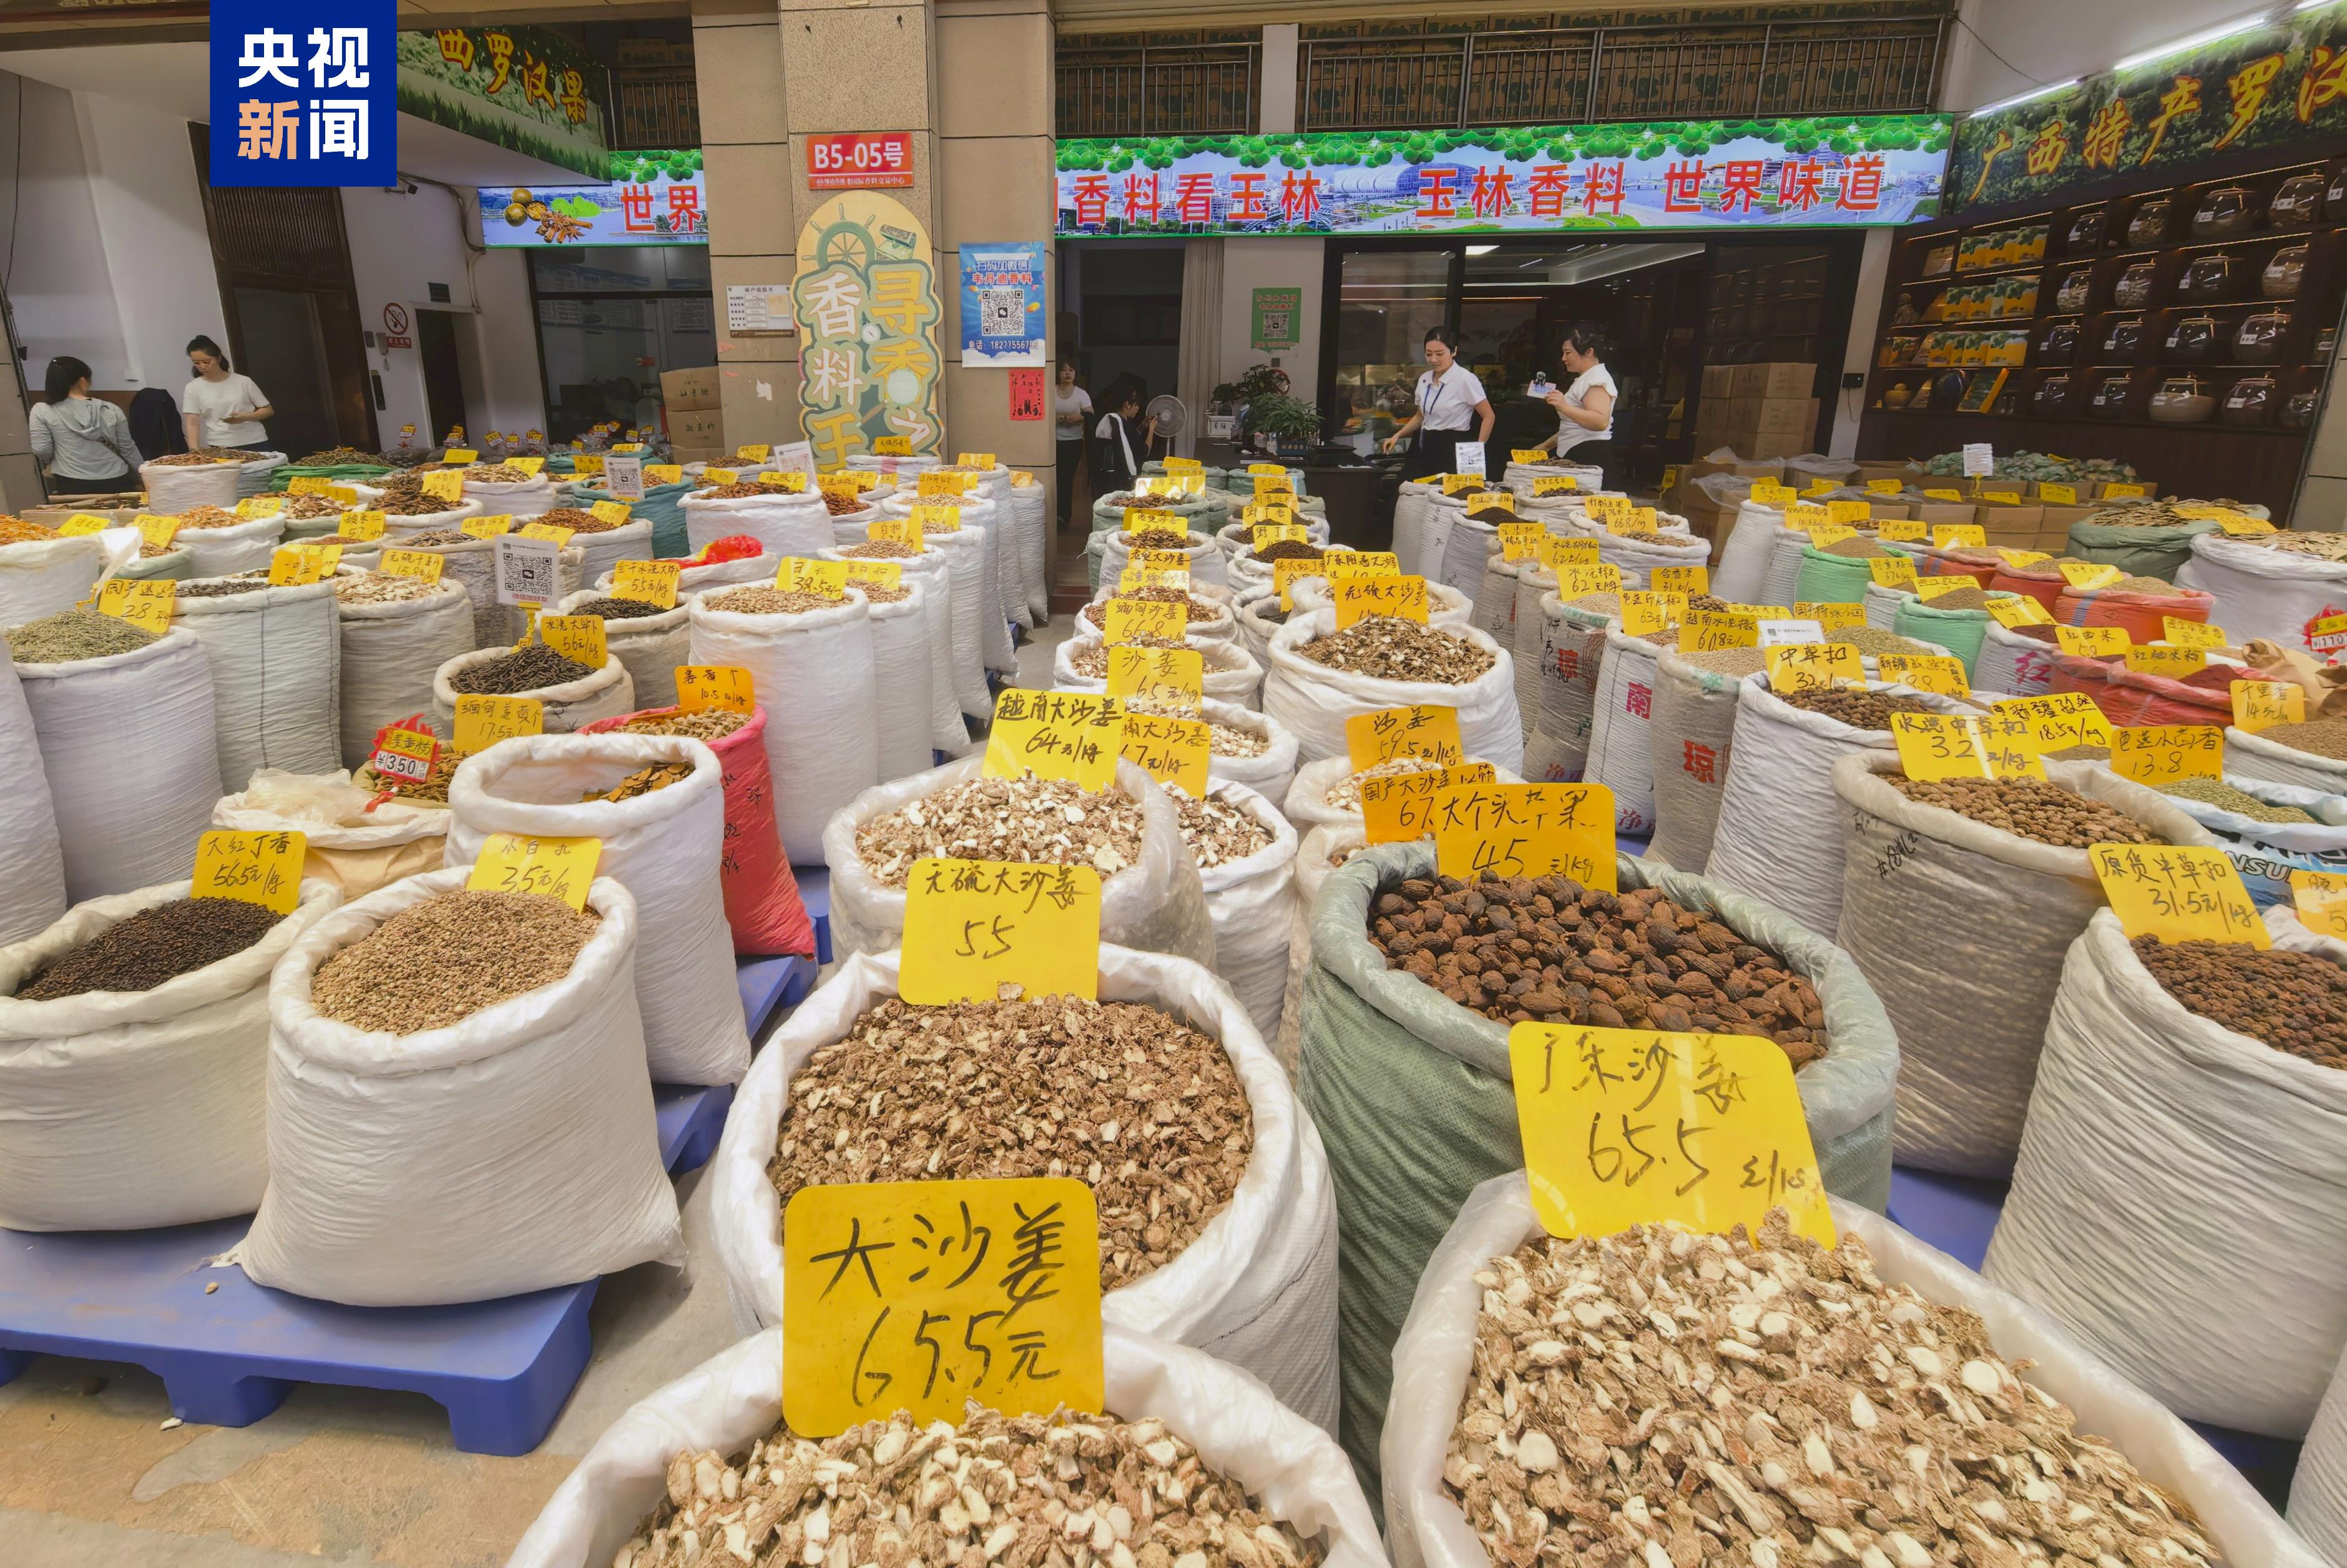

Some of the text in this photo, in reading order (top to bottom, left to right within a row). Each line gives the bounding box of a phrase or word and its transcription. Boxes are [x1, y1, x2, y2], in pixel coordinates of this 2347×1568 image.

[814, 142, 904, 169] B5-05号
[620, 184, 705, 233] 世界
[1054, 154, 1886, 226] 香料看玉林 玉林香料 世界味道
[1122, 650, 1182, 677] 沙姜
[997, 693, 1122, 727] 越南大沙姜
[1374, 707, 1435, 735] 沙姜
[207, 831, 291, 860] 大红丁香
[924, 860, 1093, 914] 无硫大沙姜
[955, 915, 1015, 959] 55
[809, 1200, 1066, 1330] 大沙姜
[850, 1306, 1061, 1408] 65.5元
